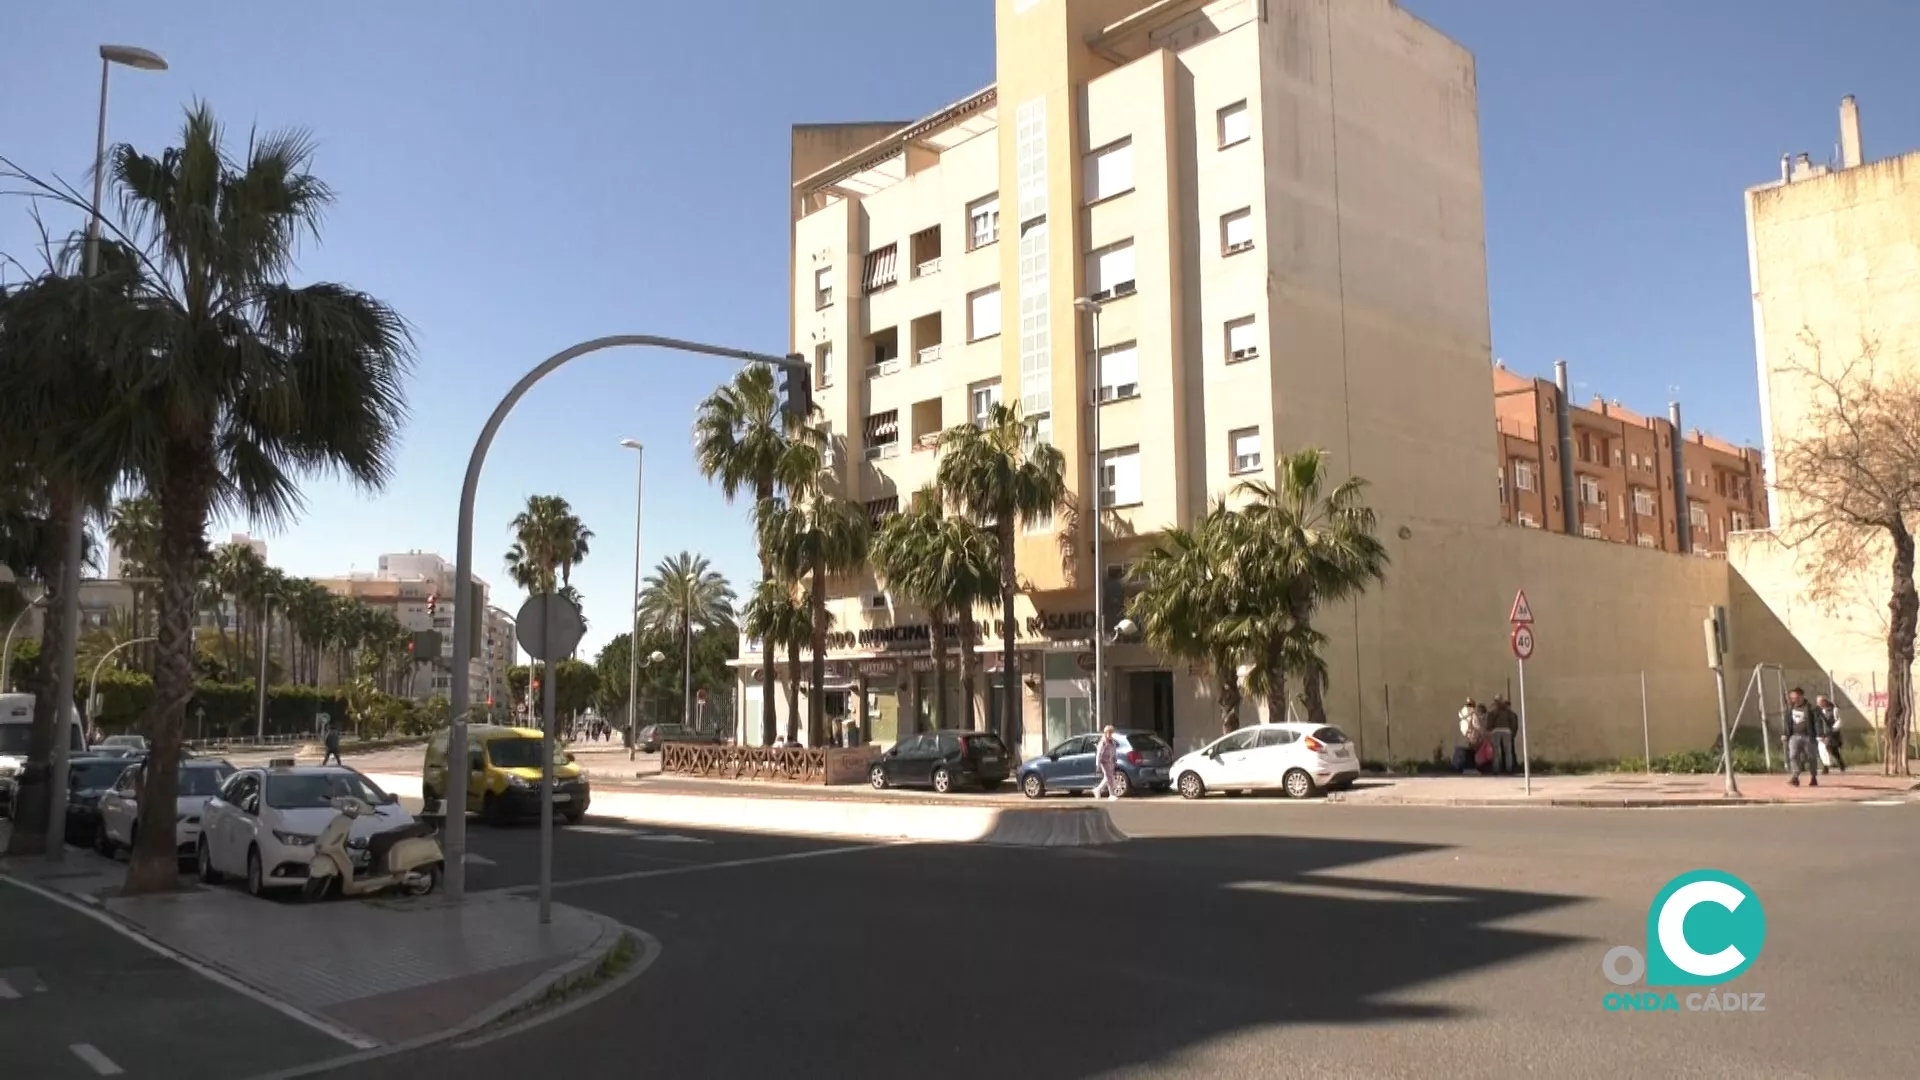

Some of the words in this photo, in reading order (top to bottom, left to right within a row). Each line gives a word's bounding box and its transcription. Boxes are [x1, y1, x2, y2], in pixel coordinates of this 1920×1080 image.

[859, 625, 930, 644] MUNICIPAL
[1026, 610, 1096, 635] ROSARIO
[1518, 635, 1530, 648] 40
